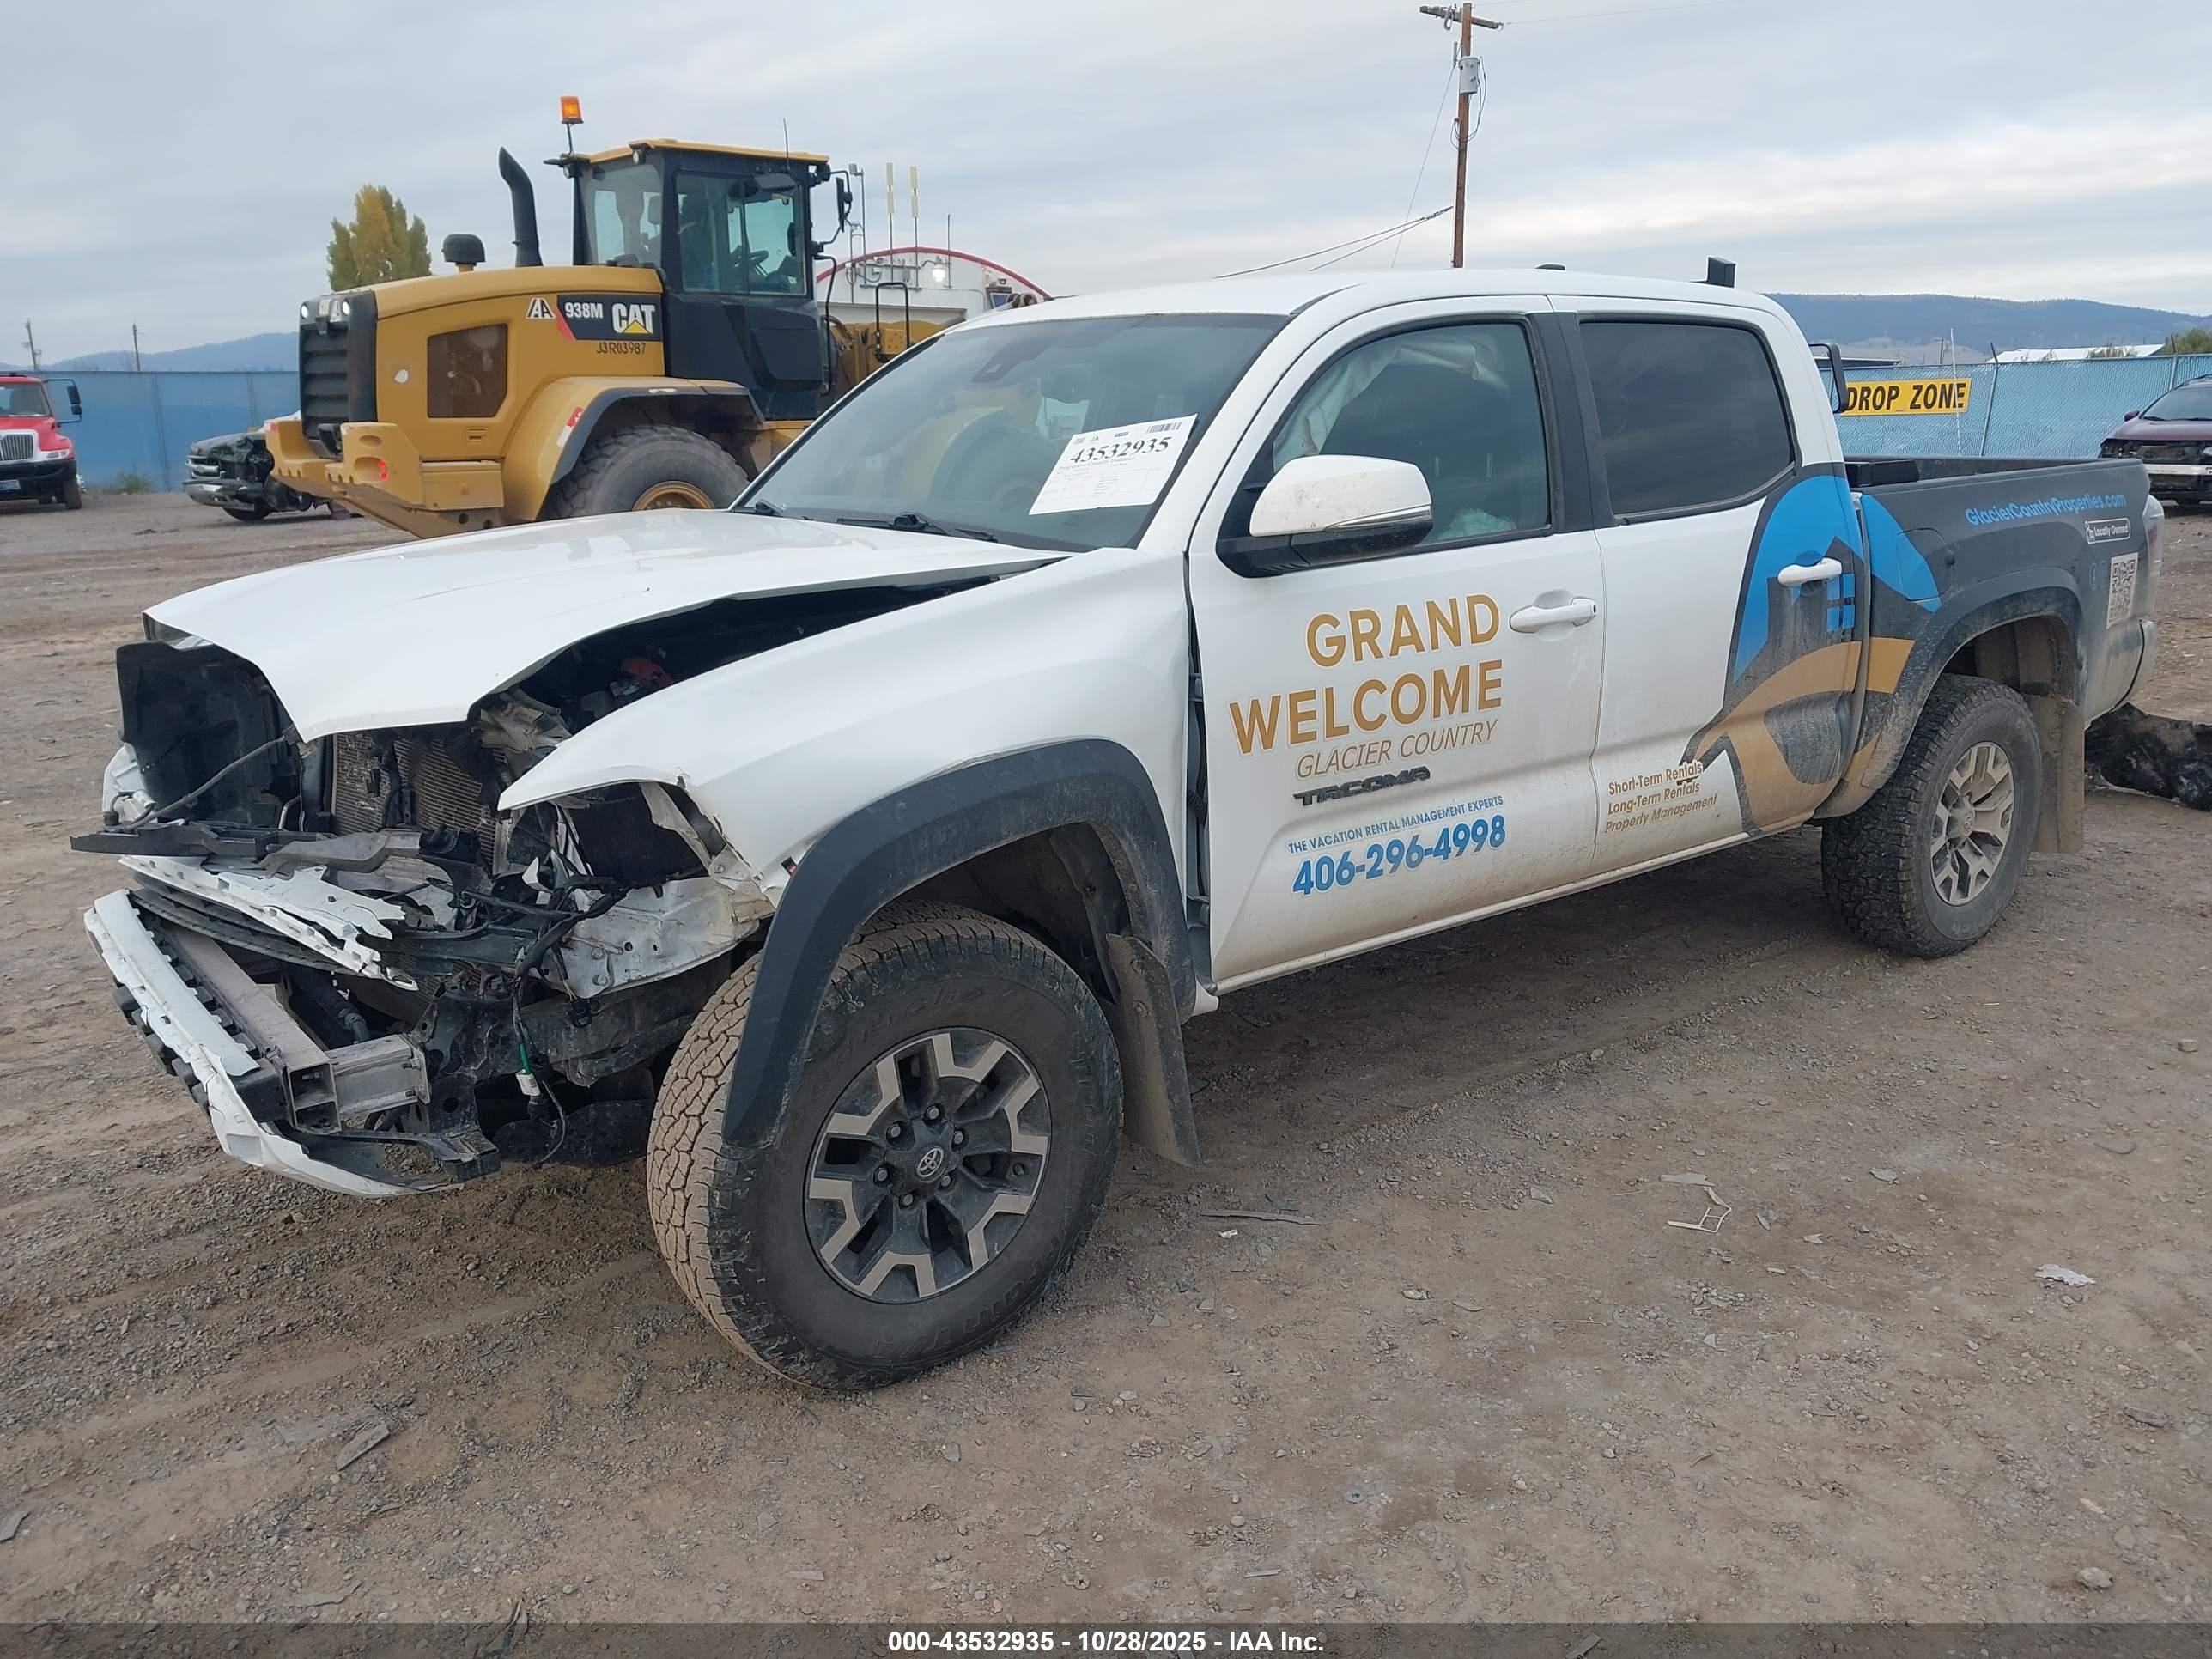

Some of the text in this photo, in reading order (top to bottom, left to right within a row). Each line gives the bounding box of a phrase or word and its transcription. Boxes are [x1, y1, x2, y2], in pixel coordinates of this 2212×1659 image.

[564, 301, 604, 319] 938M
[611, 302, 656, 334] CAT
[1847, 382, 1967, 411] DROP ZONE
[1070, 435, 1173, 464] 43532935
[1964, 493, 2127, 526] GlacierCountryProperties.com
[1305, 593, 1501, 668] GRAND
[1228, 659, 1503, 755] WELCOME
[1297, 718, 1498, 779] GLACIER COUNTRY
[1292, 765, 1431, 806] TACOMA
[1608, 762, 1703, 795] Short-Term Rentals
[1604, 793, 1718, 834] Property Management
[1607, 781, 1700, 816] Long-Term Rentals
[1288, 795, 1504, 854] THE VACATION RENTAL MANAGEMENT EXPERTS
[1291, 814, 1506, 896] 406-296-4998
